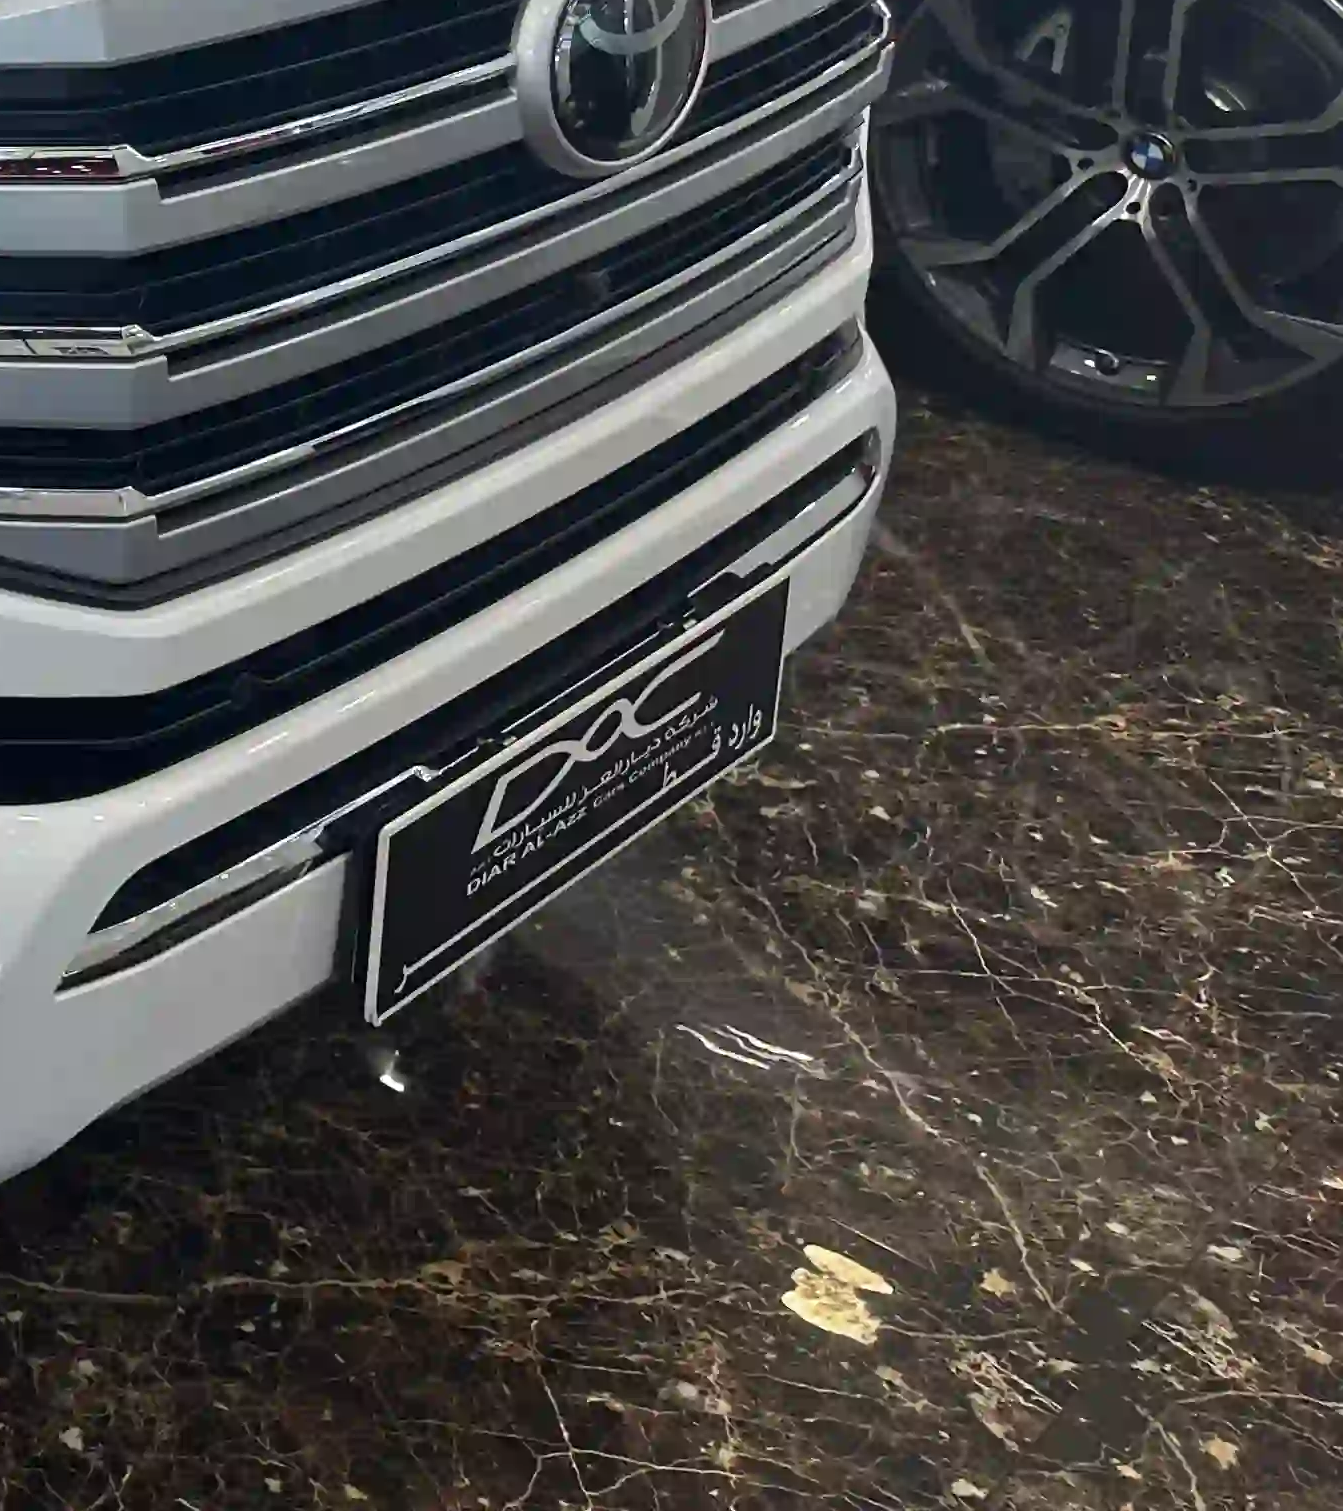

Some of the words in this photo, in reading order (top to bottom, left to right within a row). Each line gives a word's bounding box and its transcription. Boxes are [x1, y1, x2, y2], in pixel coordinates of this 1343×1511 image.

[665, 694, 719, 741] شركة
[728, 702, 763, 750] وارد
[493, 791, 577, 857] للسيارات
[467, 853, 517, 896] DIAR
